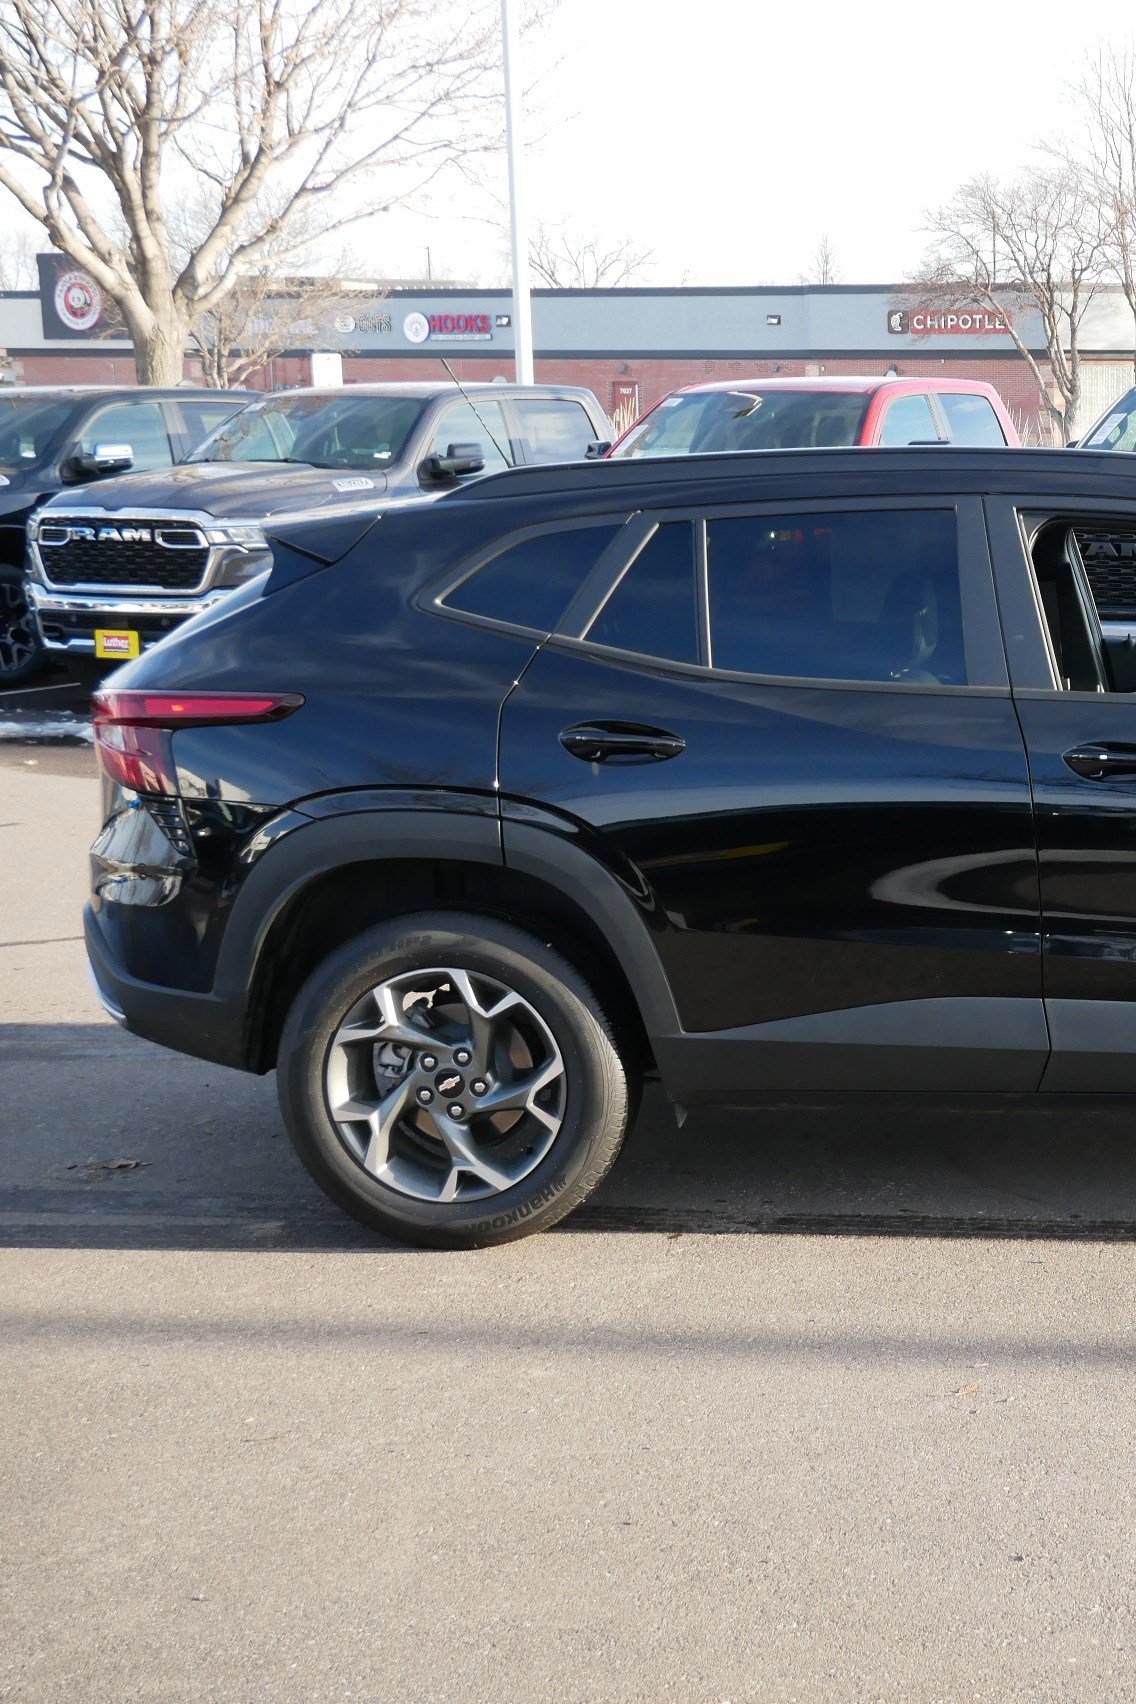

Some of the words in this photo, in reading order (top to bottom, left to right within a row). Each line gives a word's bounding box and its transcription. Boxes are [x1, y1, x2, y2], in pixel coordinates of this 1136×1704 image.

[430, 314, 491, 333] HOOKS
[913, 314, 1005, 330] CHIPOTLE
[71, 527, 152, 541] RAM
